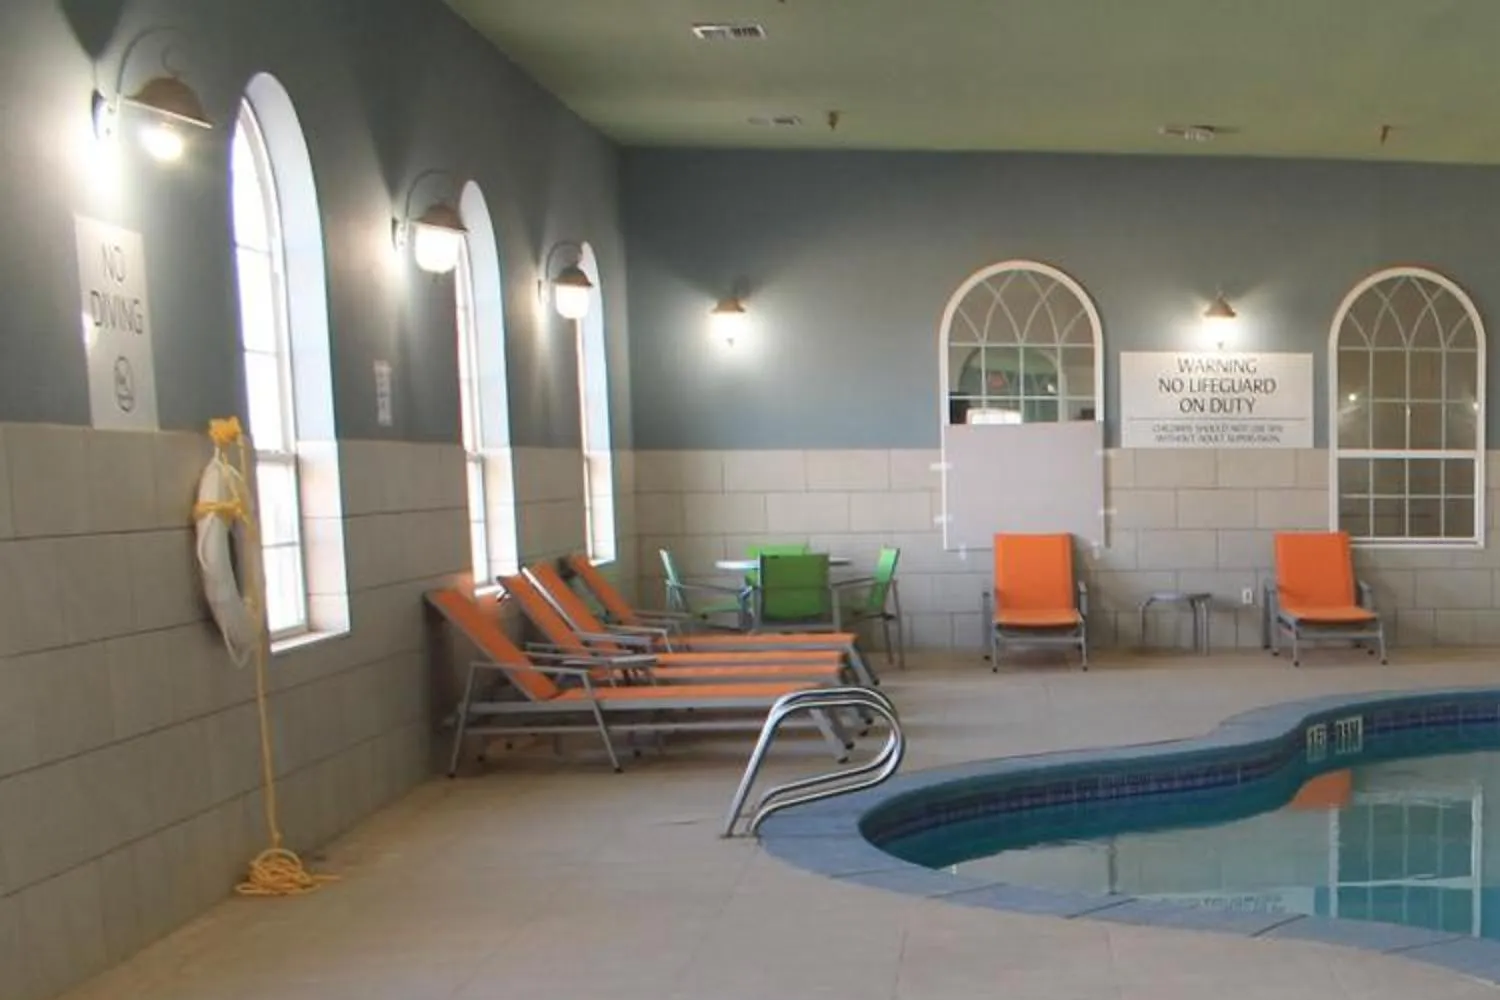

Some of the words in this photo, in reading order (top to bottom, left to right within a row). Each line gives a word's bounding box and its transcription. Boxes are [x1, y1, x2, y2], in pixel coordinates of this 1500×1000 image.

[101, 243, 126, 283] NO
[90, 290, 144, 335] DIVING
[1177, 357, 1257, 373] WARNING
[1158, 378, 1184, 394] NO
[1189, 378, 1277, 394] LIFEGUARD
[1179, 397, 1205, 413] ON
[1209, 397, 1257, 414] DUTY
